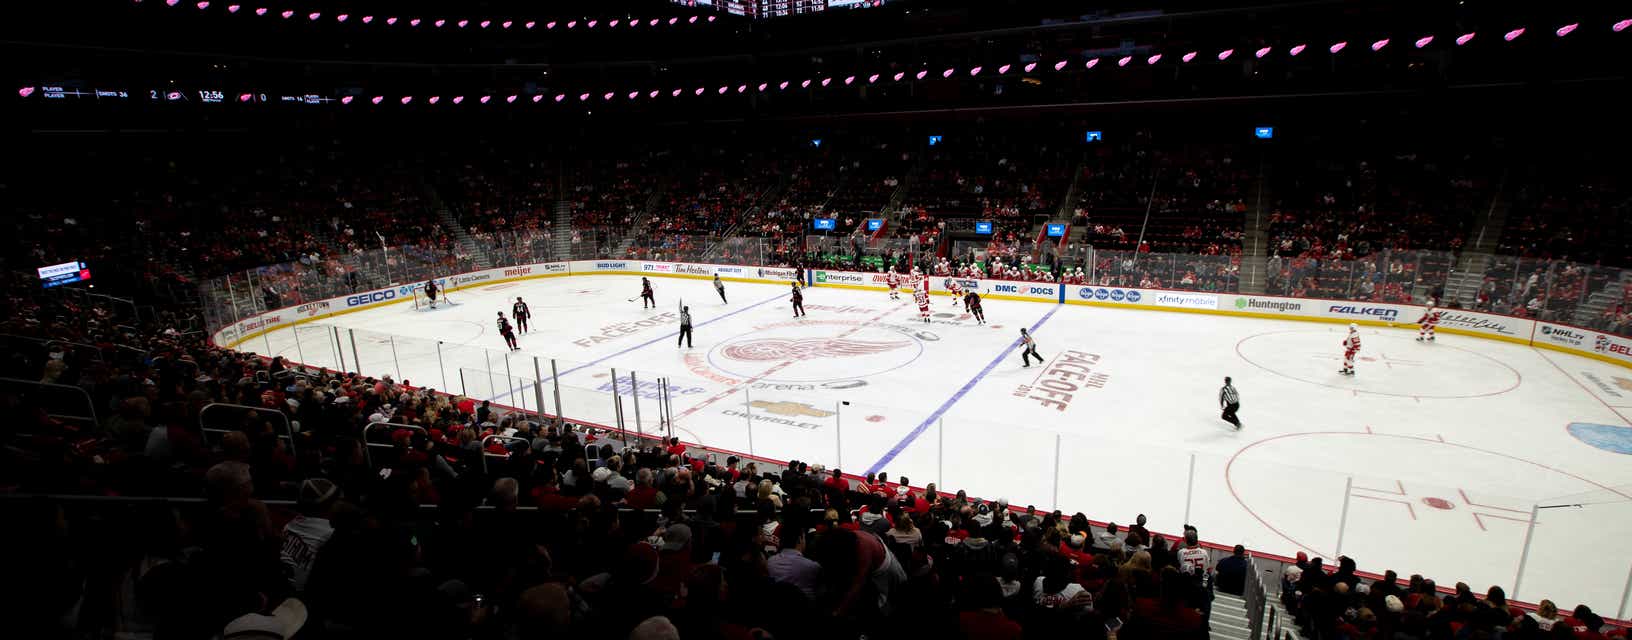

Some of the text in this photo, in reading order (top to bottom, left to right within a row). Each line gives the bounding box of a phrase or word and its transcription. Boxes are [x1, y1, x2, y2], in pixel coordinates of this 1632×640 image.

[150, 90, 158, 99] 2
[199, 90, 224, 99] 12:56
[504, 265, 532, 276] meijer
[995, 284, 1054, 296] DMC DOCS
[347, 289, 395, 307] GEICO
[1248, 298, 1301, 311] Huntington
[1329, 305, 1399, 317] FALKEN
[721, 409, 823, 430] CHEVROLET
